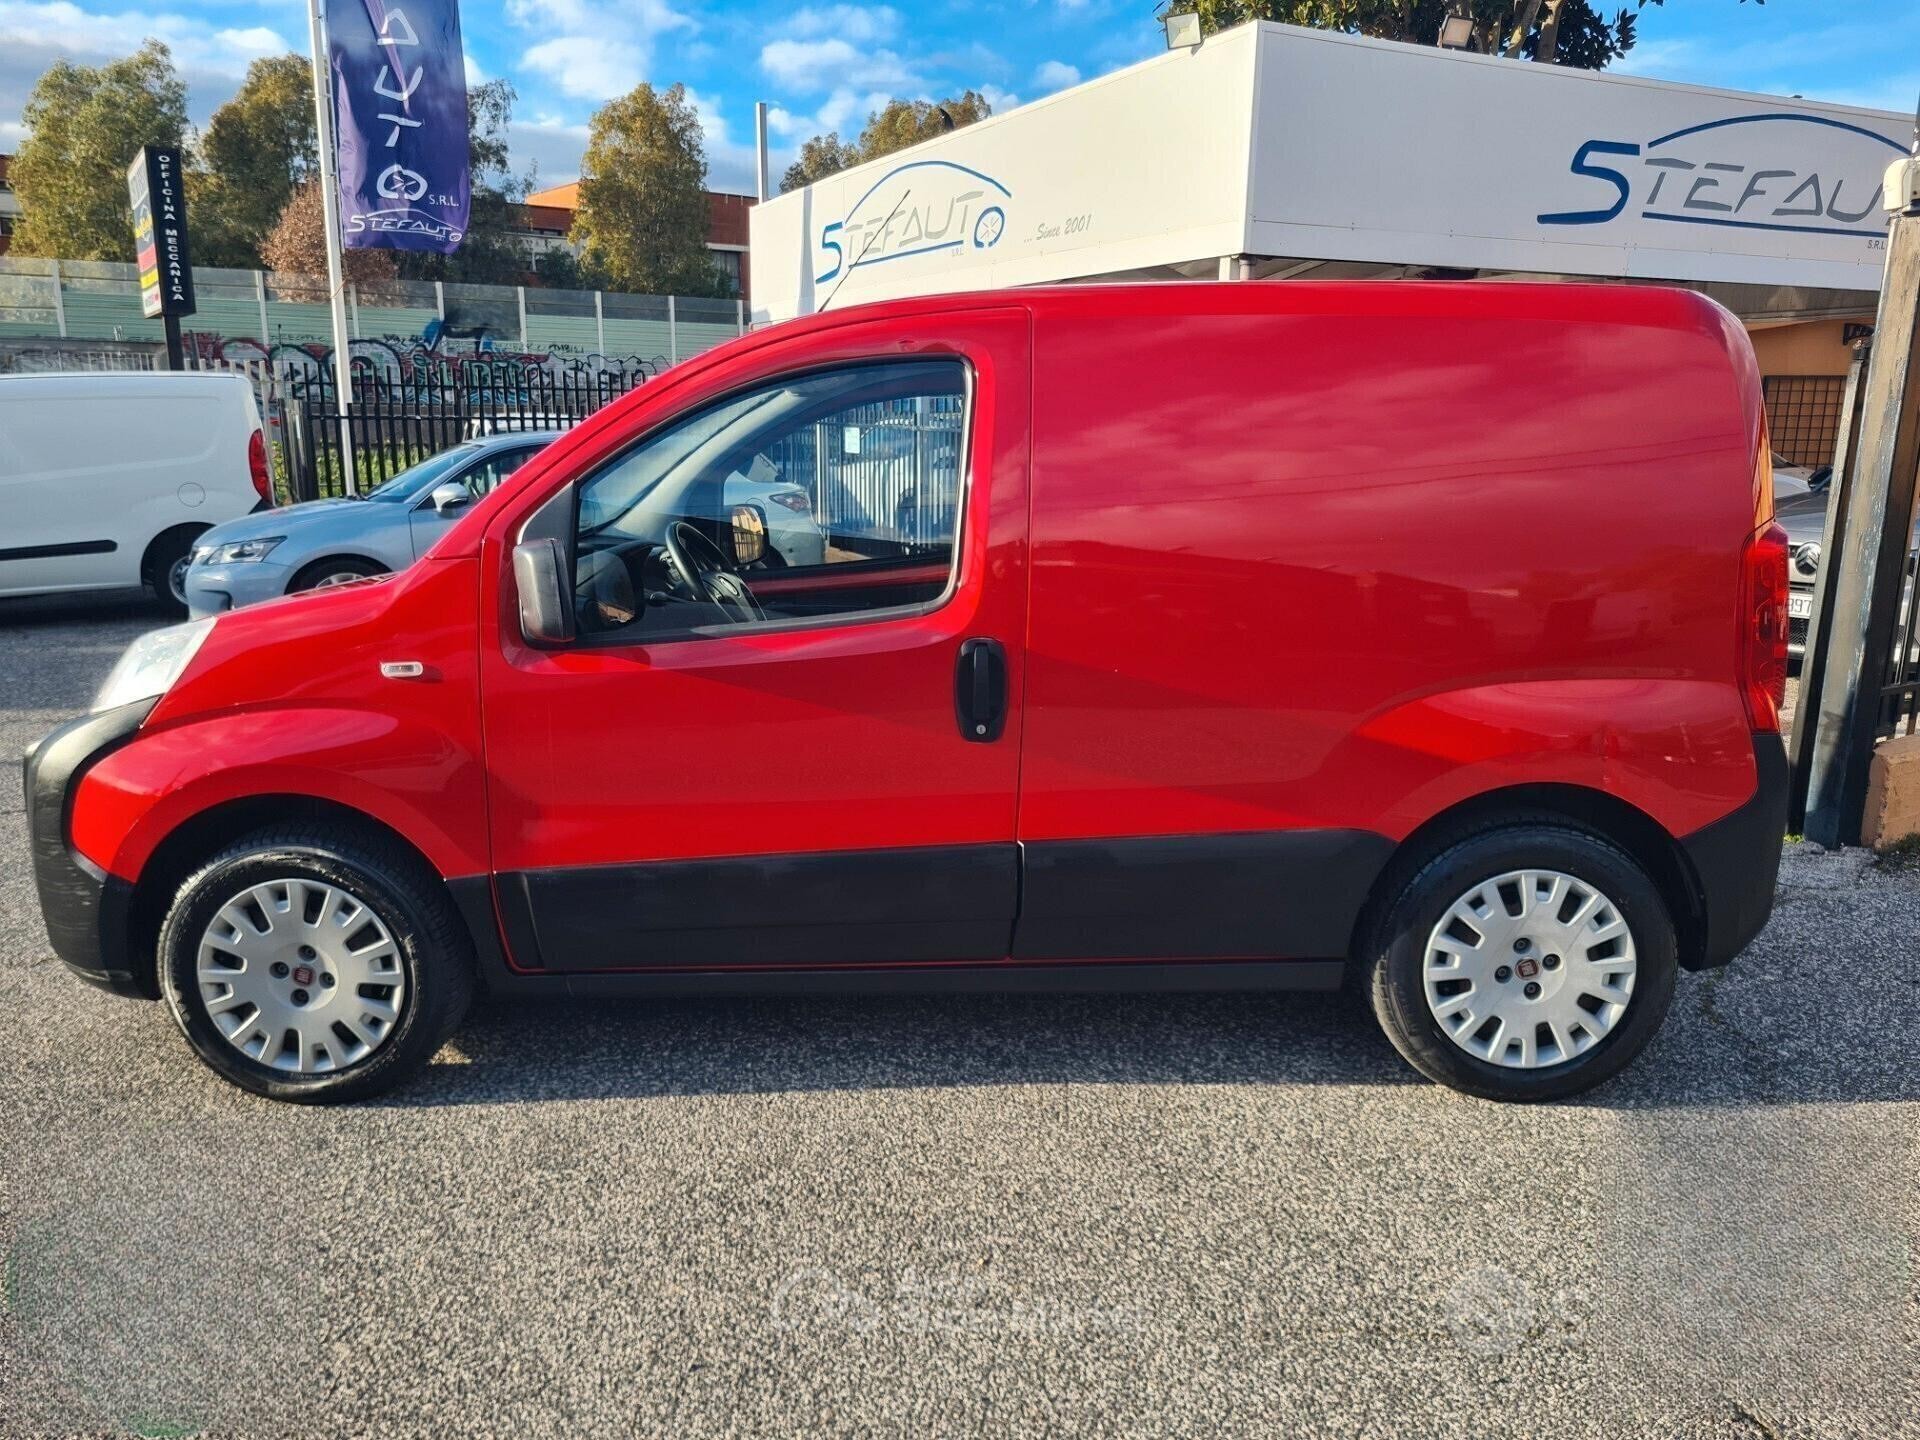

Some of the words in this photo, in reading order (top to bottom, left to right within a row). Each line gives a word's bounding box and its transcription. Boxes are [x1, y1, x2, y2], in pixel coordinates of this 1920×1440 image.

[158, 155, 177, 221] OFFICINA
[428, 194, 460, 208] S.R.L.
[1536, 139, 1891, 226] STEFAU
[346, 214, 462, 242] STEFAUTO
[815, 190, 1005, 285] STEFAUTO
[1035, 221, 1061, 241] Since
[1064, 213, 1092, 235] 2001
[165, 228, 185, 301] MECCANICA
